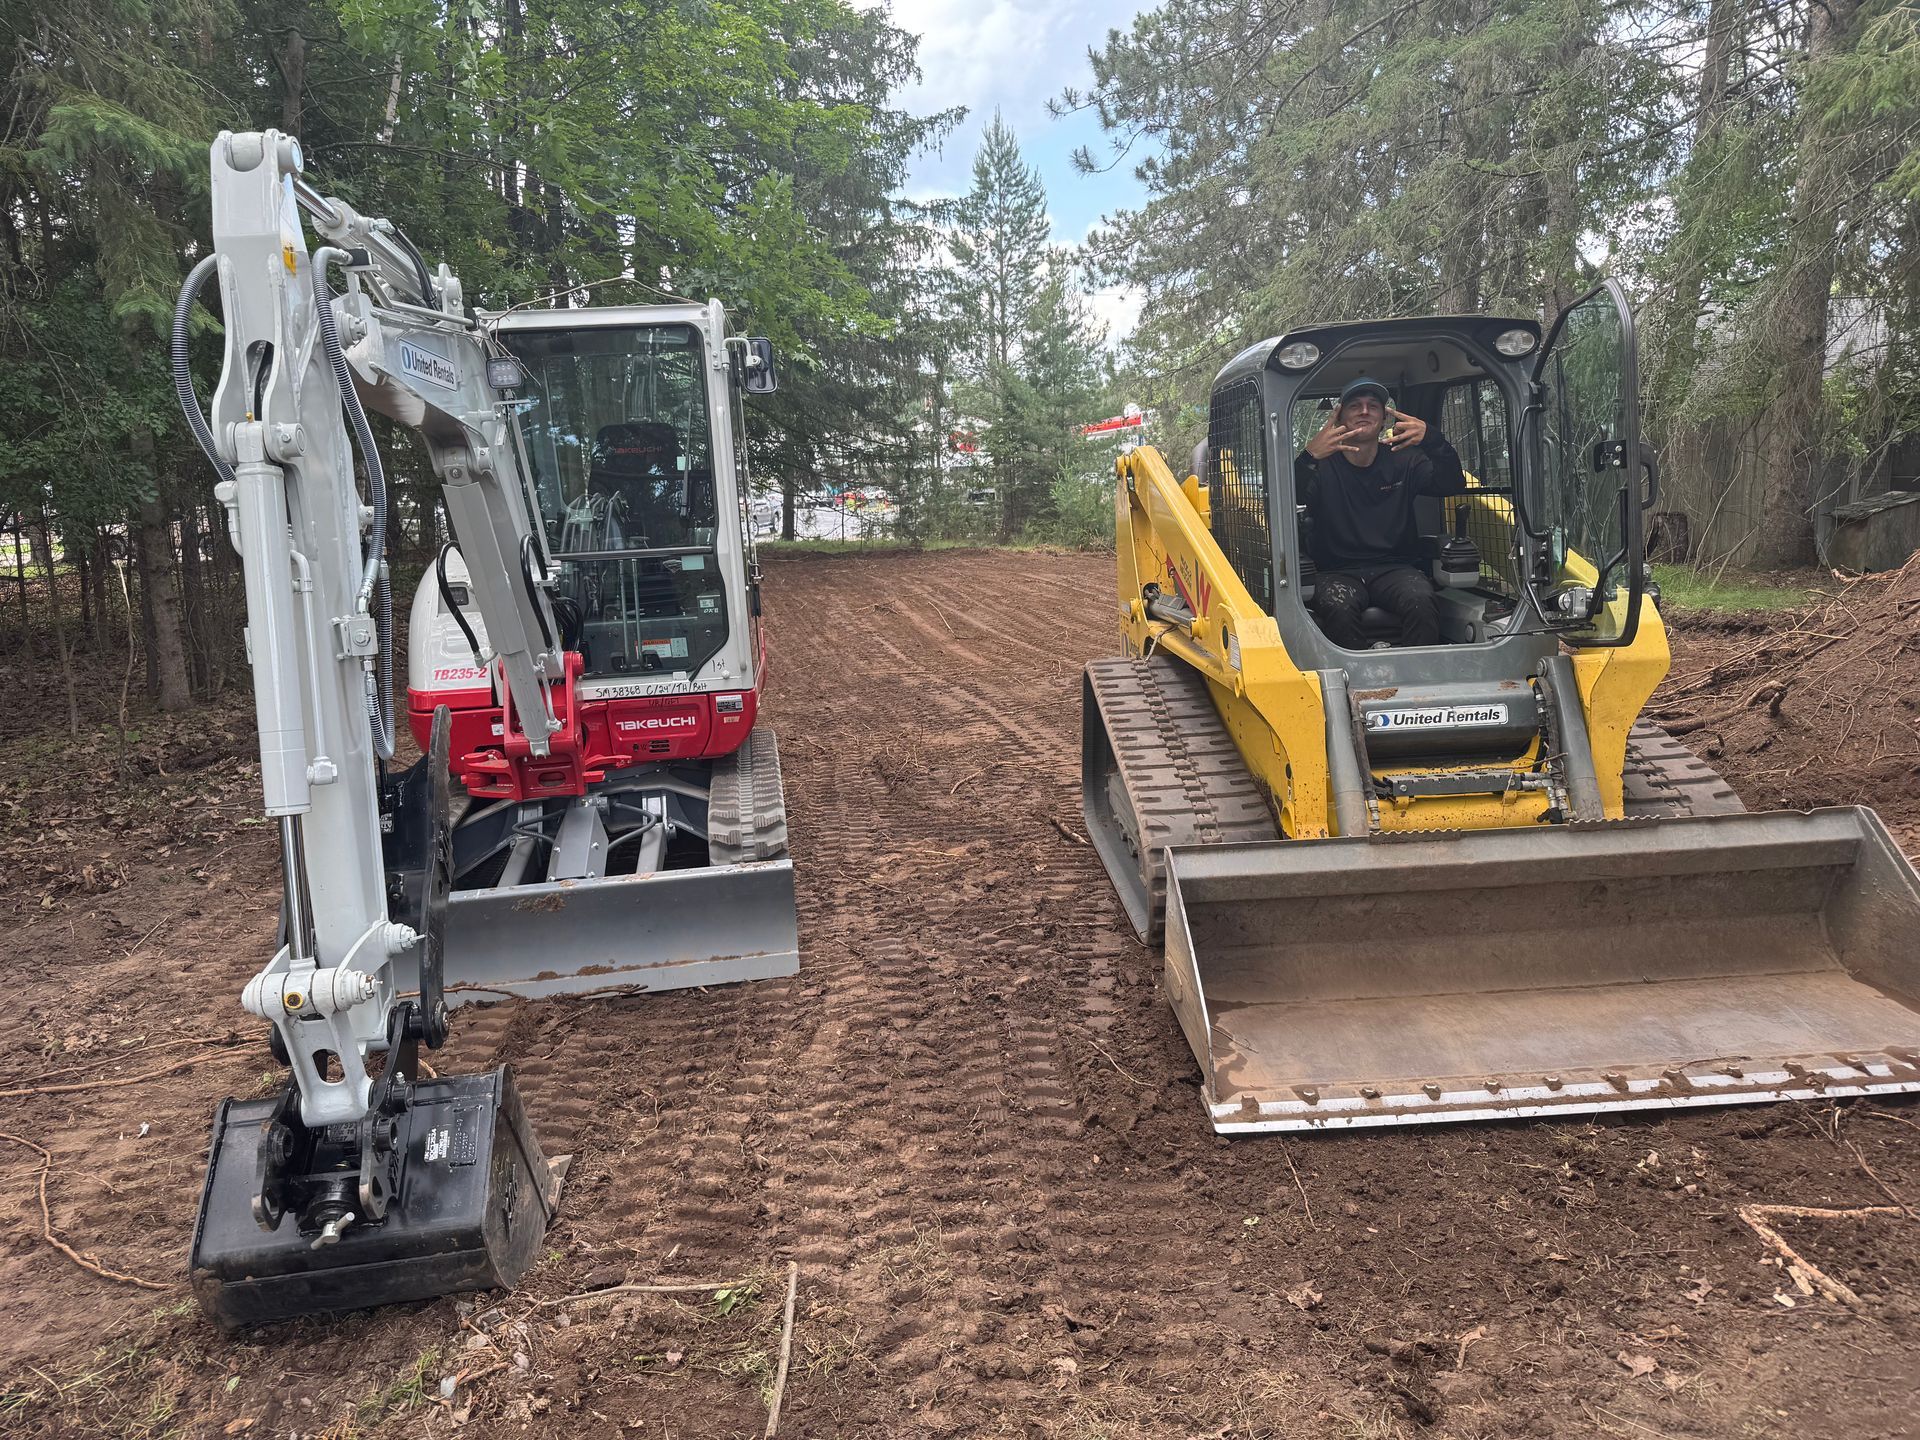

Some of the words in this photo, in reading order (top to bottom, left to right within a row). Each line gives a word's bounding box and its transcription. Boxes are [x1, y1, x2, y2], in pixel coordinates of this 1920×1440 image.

[411, 350, 433, 377] United
[433, 359, 455, 385] Rentals
[433, 667, 488, 681] TB235-2
[1393, 712, 1442, 726] United
[1446, 709, 1500, 723] Rentals
